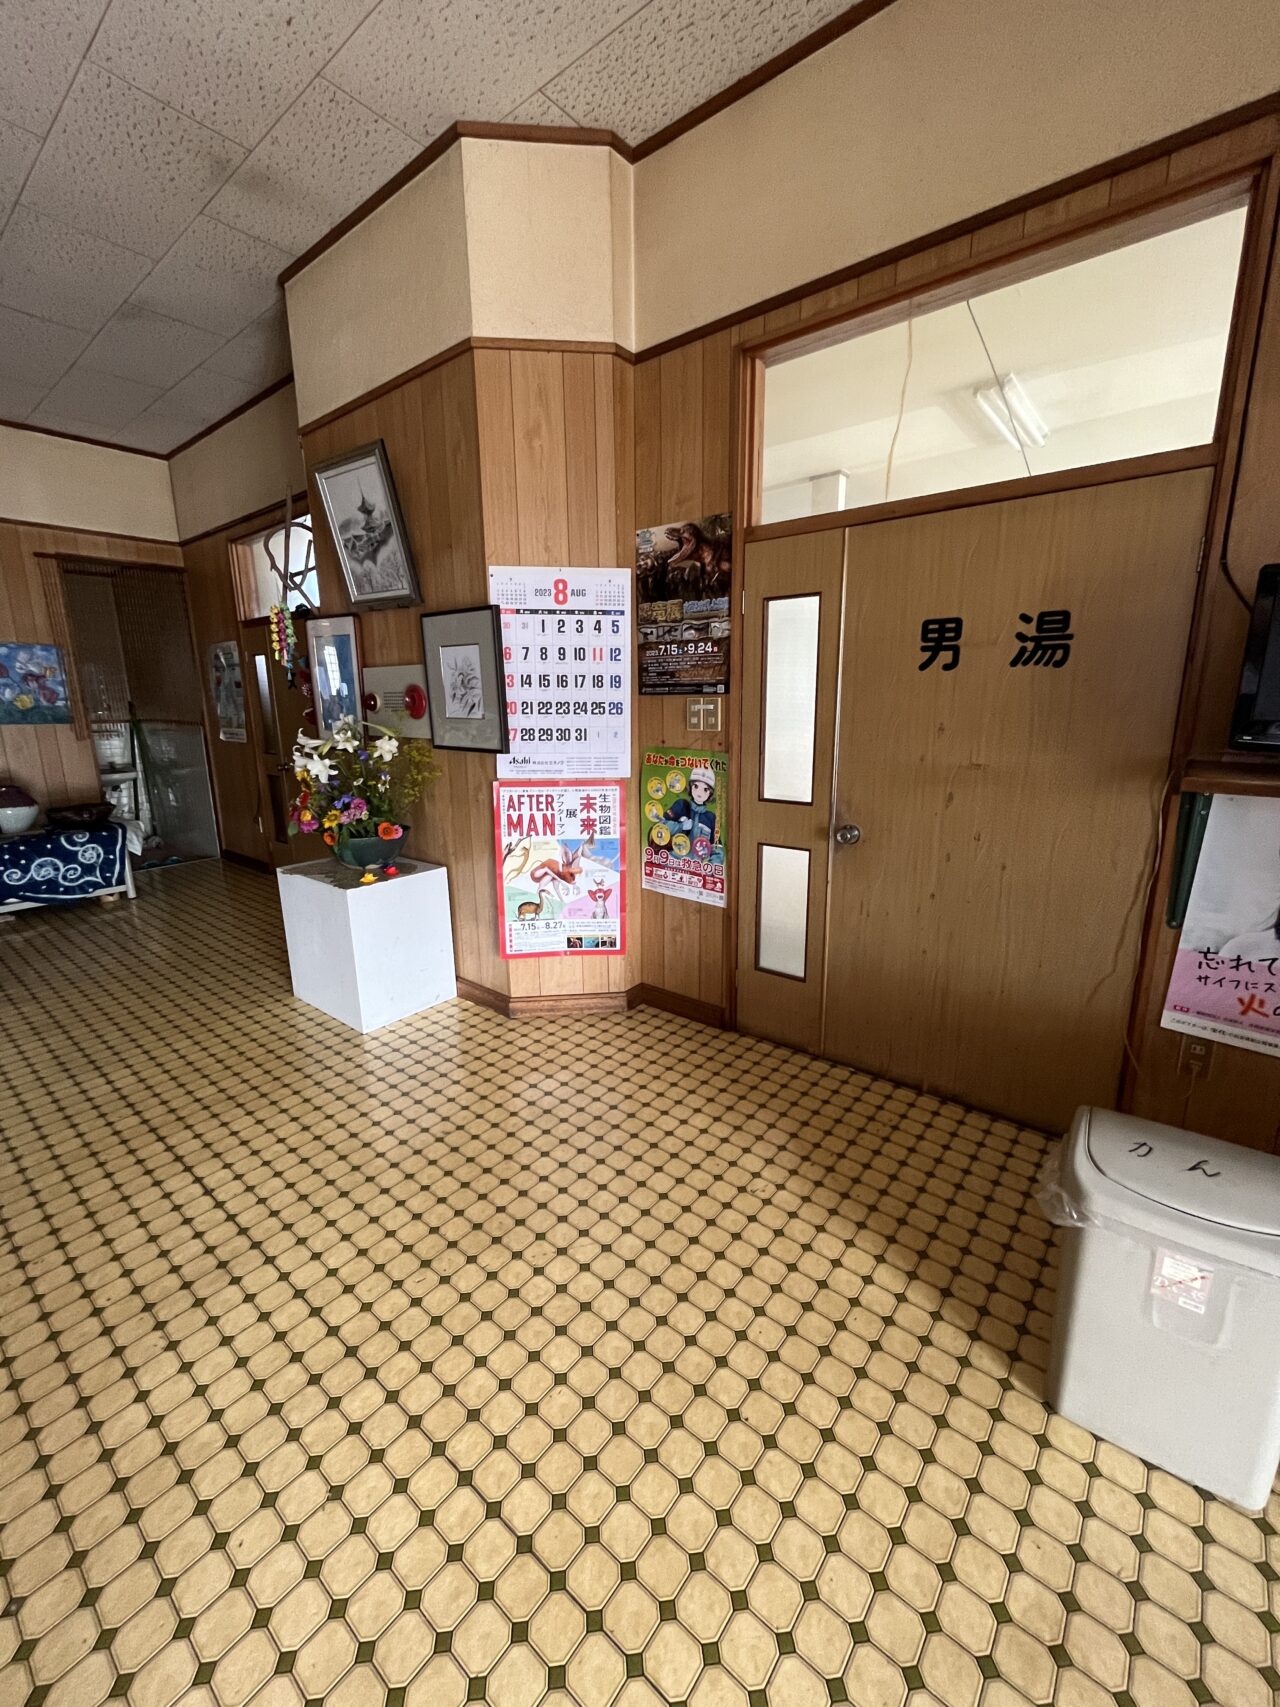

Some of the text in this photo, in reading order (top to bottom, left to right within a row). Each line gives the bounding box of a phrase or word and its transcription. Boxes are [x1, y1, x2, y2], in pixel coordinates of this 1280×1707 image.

[534, 578, 587, 606] 2023 8 AUG
[541, 619, 545, 633] 1
[557, 619, 566, 633] 2
[575, 620, 584, 634] 3
[593, 620, 602, 634] 4
[611, 620, 620, 634] 5
[659, 644, 678, 655] 7.15
[688, 642, 712, 653] 9.24
[918, 610, 1074, 671] 男 湯
[503, 646, 622, 662] 6 7 8 9 10 11 12
[520, 674, 532, 688] 14
[538, 674, 550, 688] 15
[556, 674, 568, 688] 16
[574, 675, 586, 688] 17
[592, 675, 604, 688] 18
[610, 675, 622, 688] 19
[521, 702, 533, 715] 21
[538, 702, 552, 715] 22
[556, 702, 570, 715] 23
[573, 702, 588, 715] 24
[590, 702, 606, 715] 25
[608, 702, 623, 716] 26
[520, 728, 535, 741] 28
[538, 728, 553, 741] 29
[556, 728, 570, 742] 30
[575, 728, 587, 742] 31
[506, 794, 556, 812] AFTER
[557, 794, 566, 836] アフターマン
[566, 808, 578, 818] 展
[580, 794, 597, 836] 未来
[598, 793, 611, 836] 生物図鑑
[507, 813, 556, 837] MAN
[520, 922, 536, 931] 7.15
[545, 920, 562, 930] 8.27
[1199, 946, 1279, 976] 忘れて
[1196, 974, 1277, 993] サイフにス
